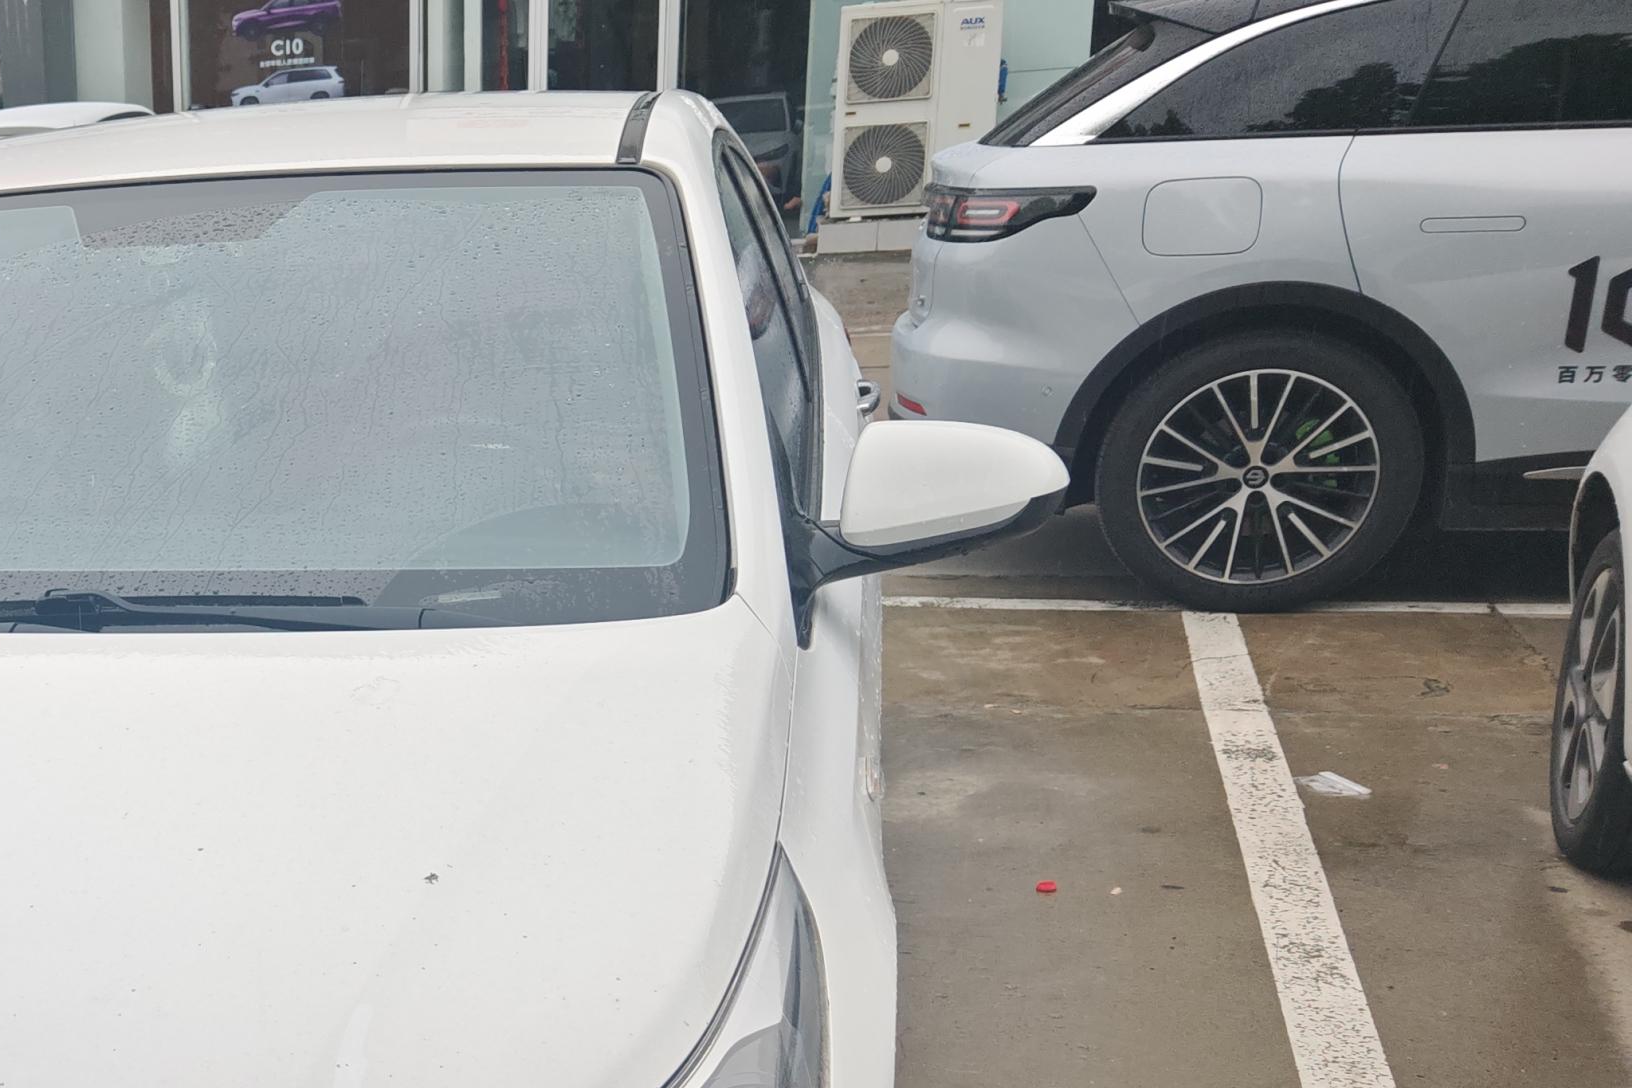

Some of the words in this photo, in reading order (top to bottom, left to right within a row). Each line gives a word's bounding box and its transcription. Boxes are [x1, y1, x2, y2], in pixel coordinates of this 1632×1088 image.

[960, 16, 985, 26] AUX
[270, 37, 304, 56] C10
[1557, 364, 1632, 384] 百万零
